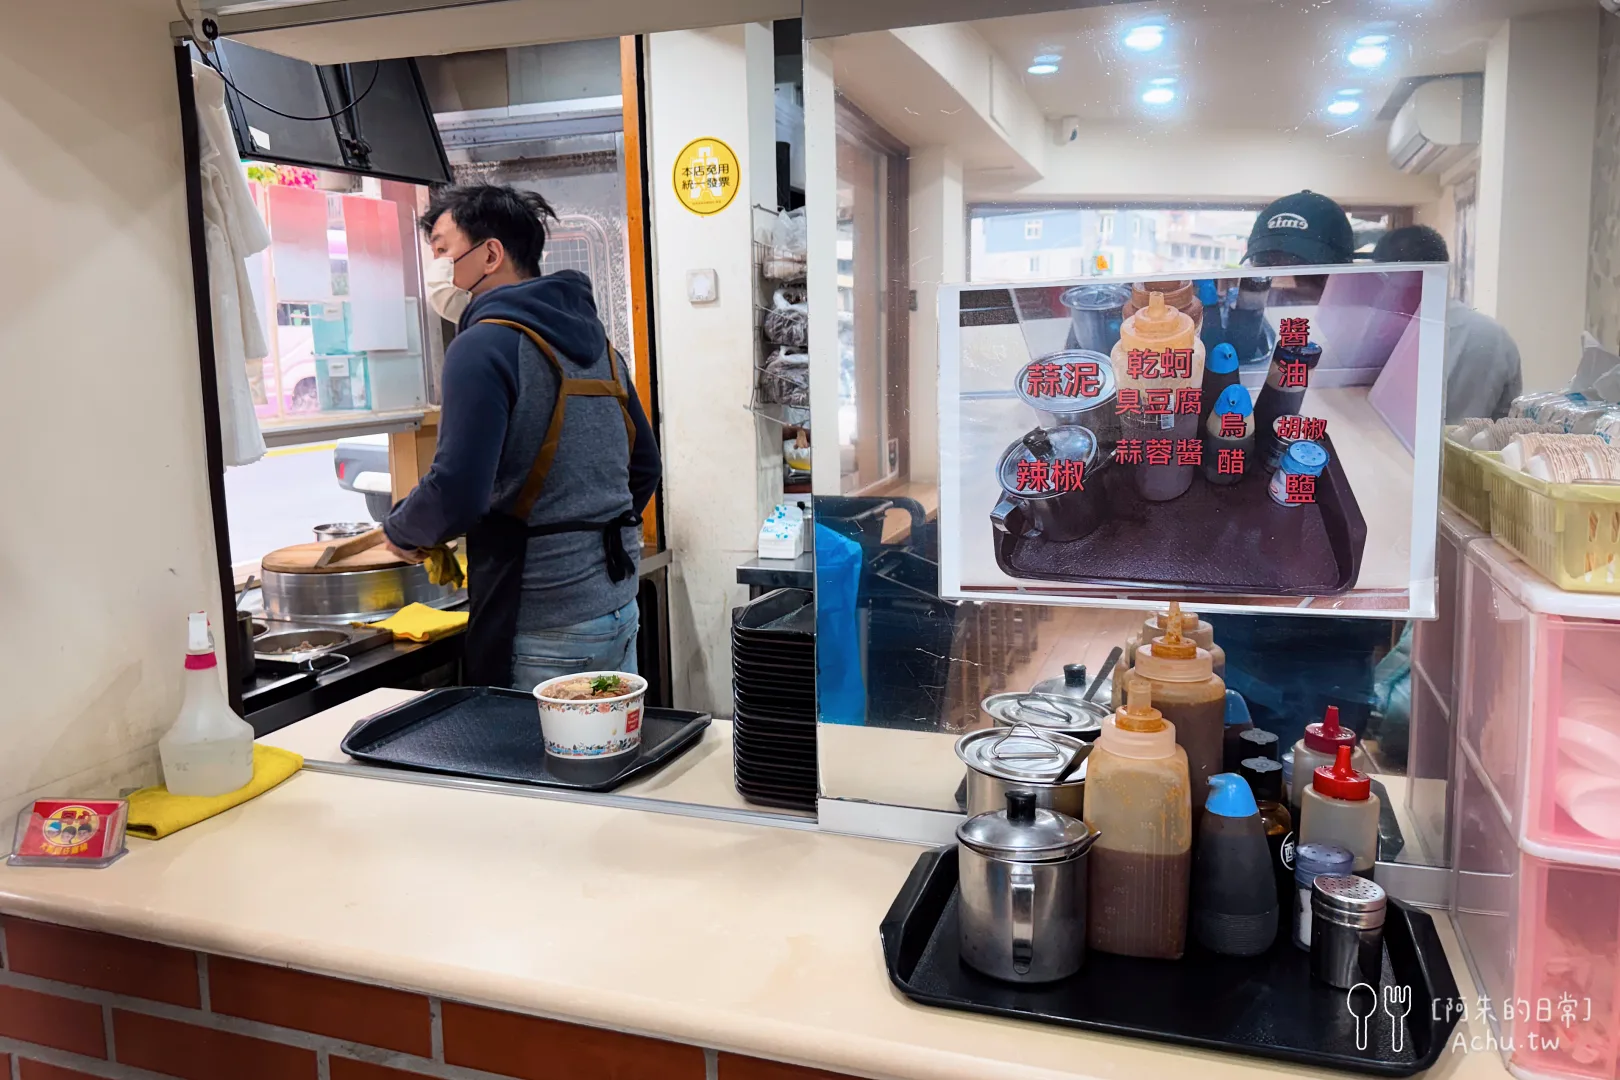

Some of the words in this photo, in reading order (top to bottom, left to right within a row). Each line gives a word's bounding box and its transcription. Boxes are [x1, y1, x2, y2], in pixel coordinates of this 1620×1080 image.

[682, 164, 729, 177] 本店免用
[682, 177, 730, 190] 統一發票
[1127, 347, 1195, 380] 乾蚵
[1278, 318, 1310, 388] 醬油
[1027, 363, 1099, 398] 蒜泥
[1115, 387, 1203, 416] 臭豆腐
[1277, 416, 1327, 441] 胡椒
[1115, 438, 1204, 467] 蒜蓉醬
[1016, 459, 1086, 493] 辣椒
[1285, 474, 1316, 504] 鹽
